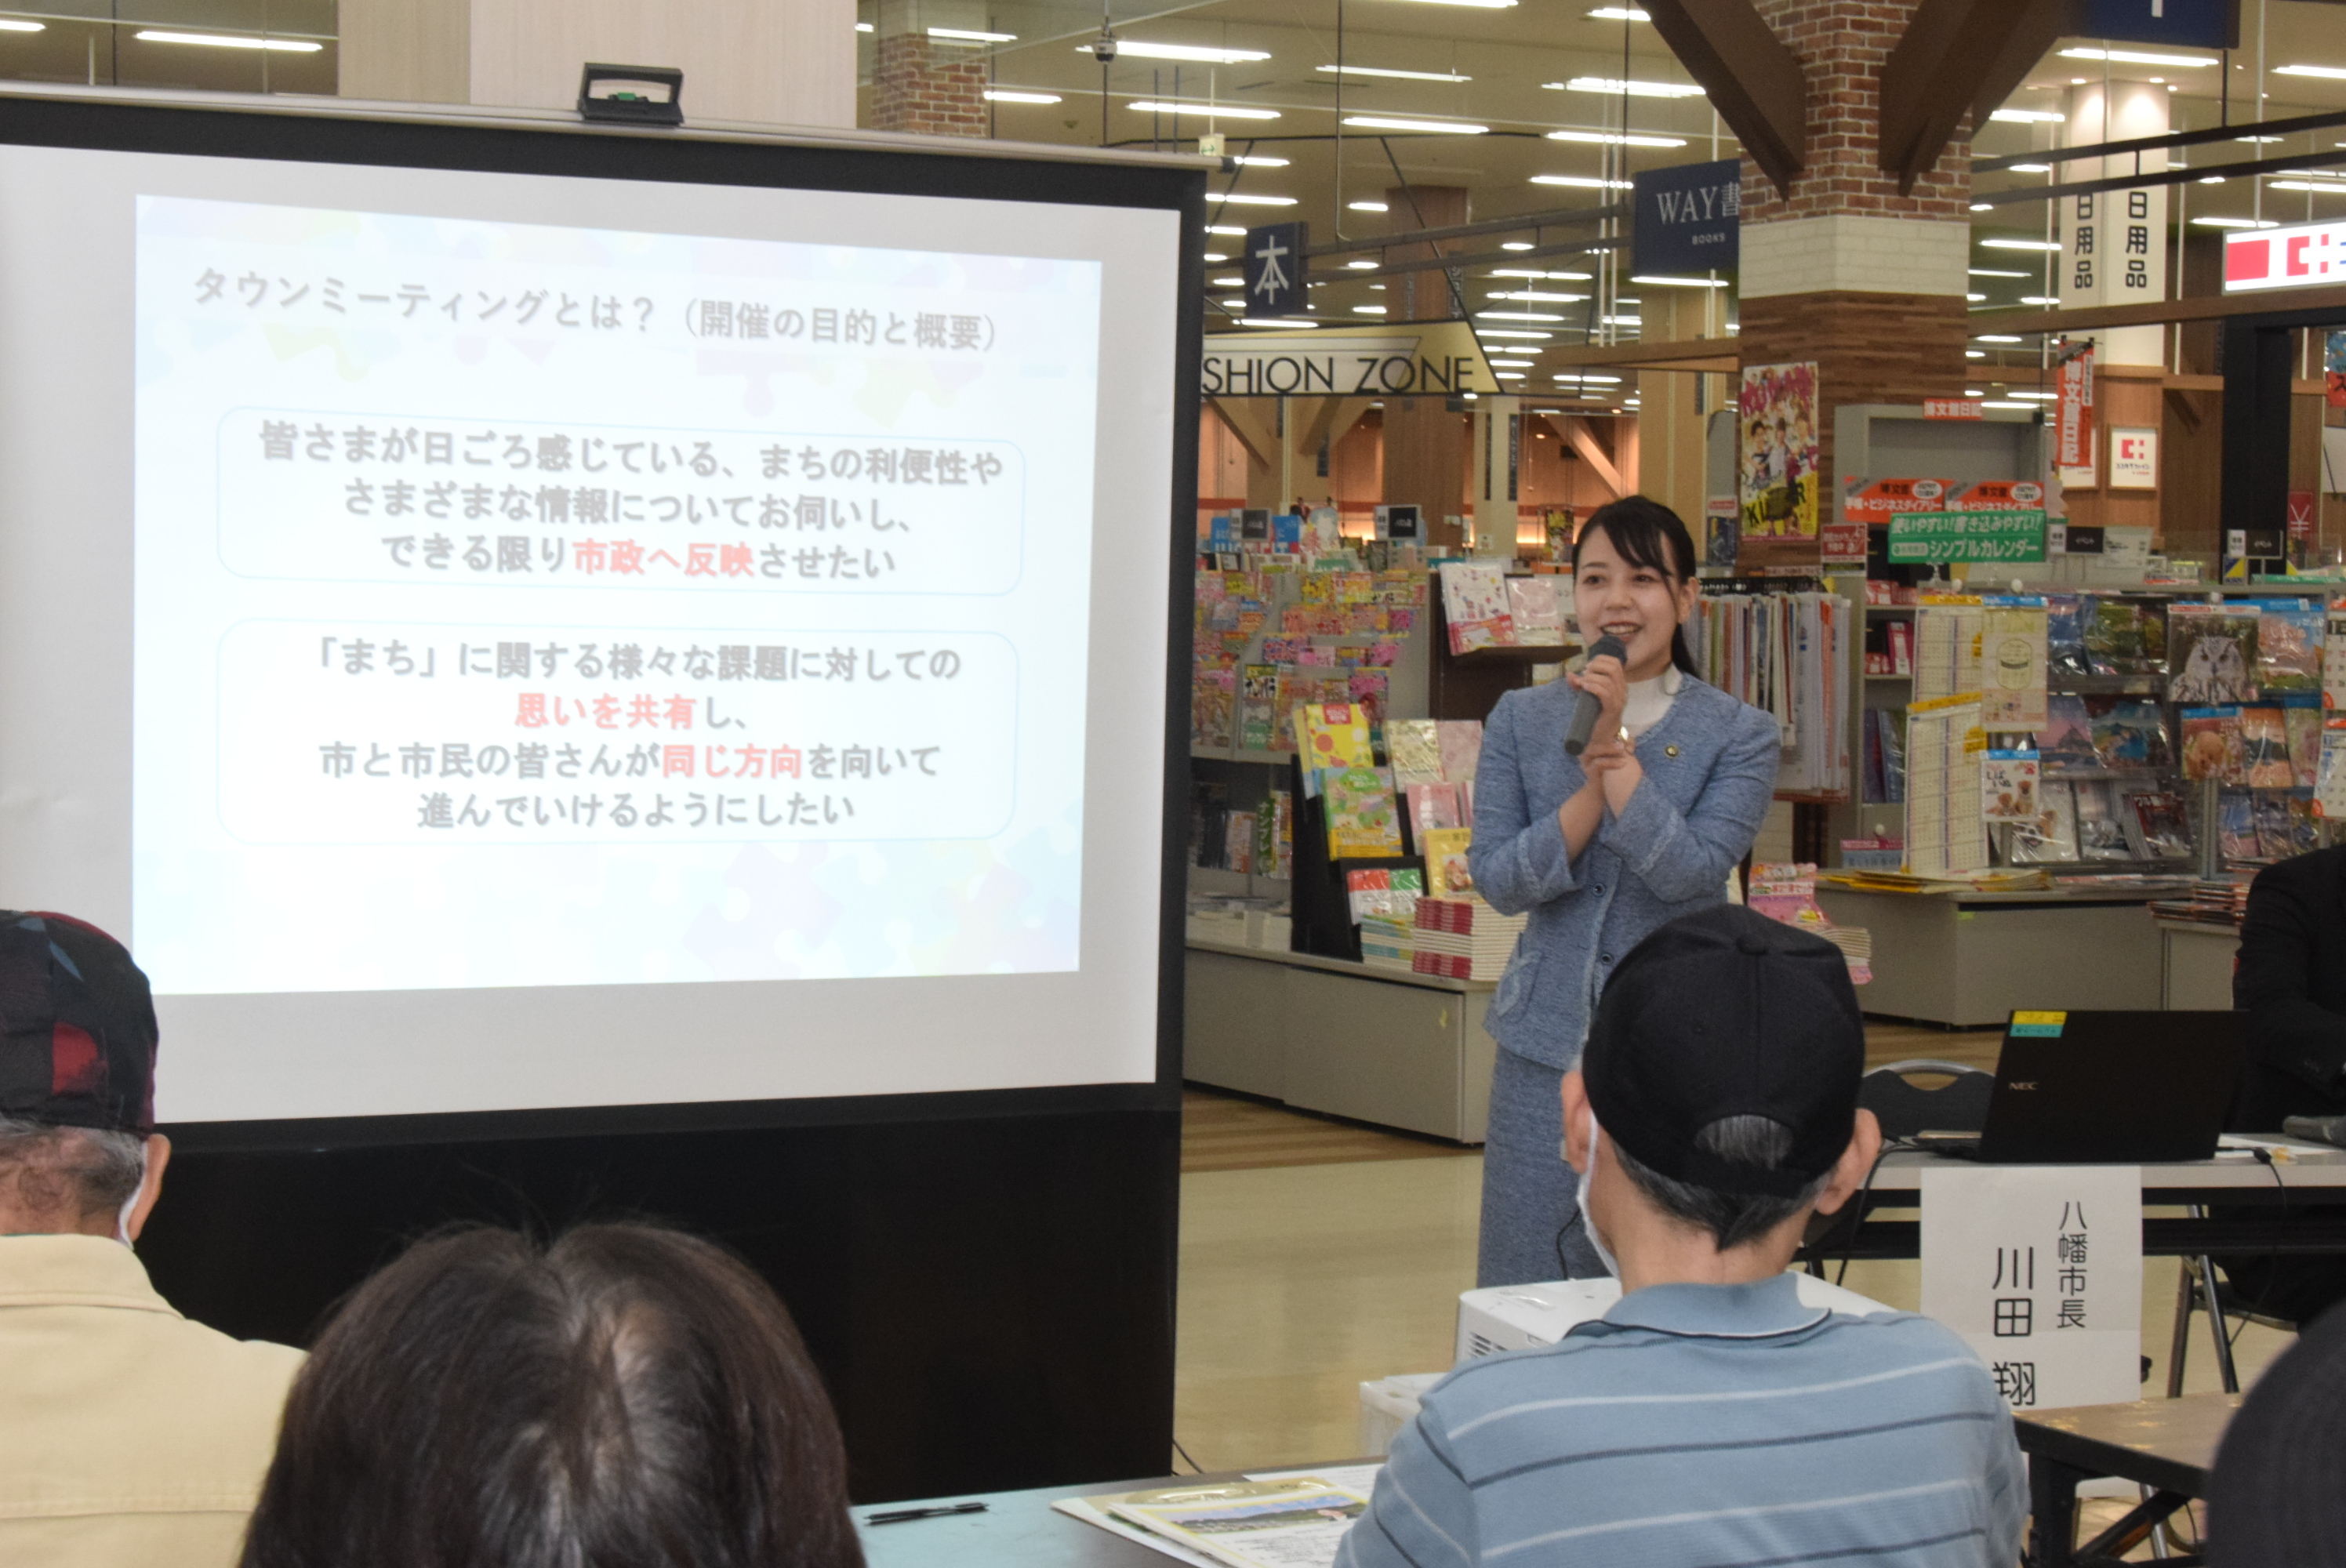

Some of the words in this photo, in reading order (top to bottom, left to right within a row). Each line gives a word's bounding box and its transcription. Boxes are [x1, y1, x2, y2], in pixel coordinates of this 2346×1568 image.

[1692, 232, 1725, 245] BOOKS
[2075, 194, 2093, 289] 日用品
[2126, 191, 2147, 288] 日用品
[1255, 234, 1289, 304] 本
[1203, 357, 1334, 394] SHION
[1355, 356, 1473, 393] ZONE
[345, 477, 910, 532] さまざまな情報についてお伺いし、
[380, 532, 895, 579] できる限り市政へ反映させたい
[1930, 539, 2039, 557] シンプルカレンダー
[515, 692, 746, 729] 思いを共有し、
[318, 741, 941, 779] 市と市民の皆さんが同じ方向を向いて
[418, 792, 854, 829] 進んでいけるようにしたい
[2057, 1201, 2087, 1328] 八幡市長
